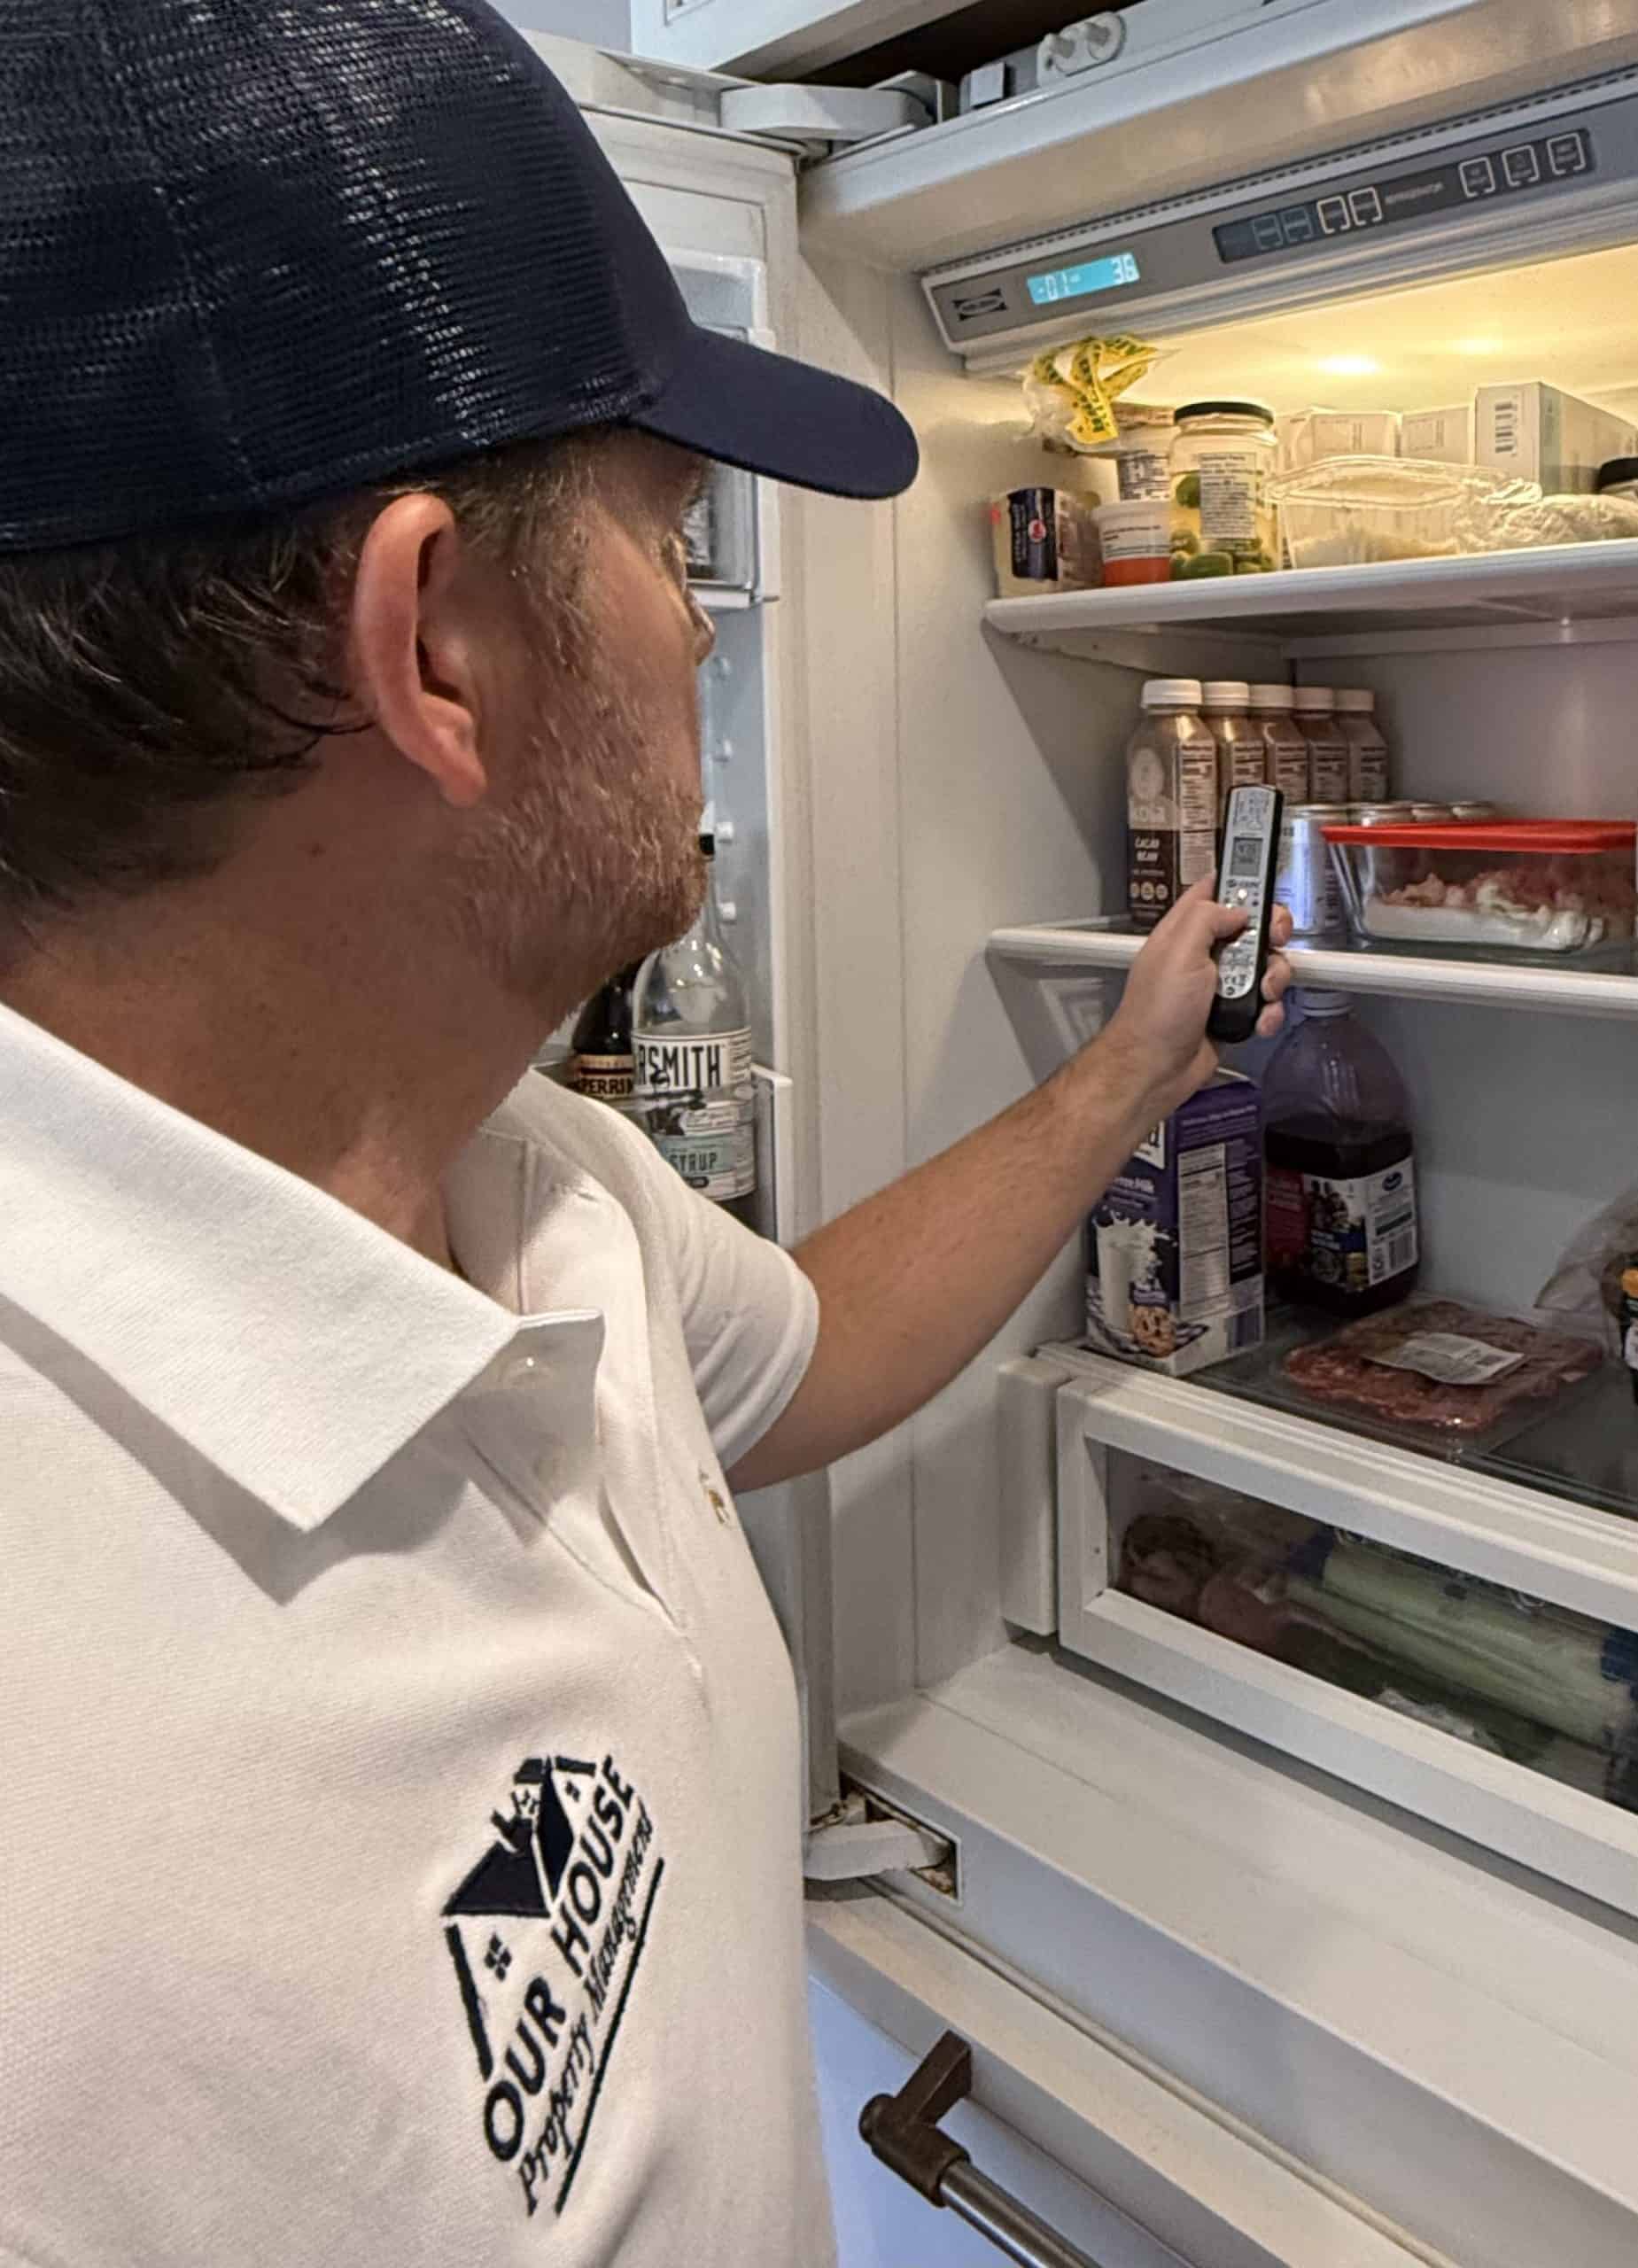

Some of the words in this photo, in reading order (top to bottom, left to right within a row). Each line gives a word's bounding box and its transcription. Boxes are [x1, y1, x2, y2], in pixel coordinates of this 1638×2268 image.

[484, 1977, 566, 2162] OUR
[550, 1754, 634, 1977] HOUSE
[519, 2011, 594, 2217] Property
[583, 1795, 653, 2024] Management
